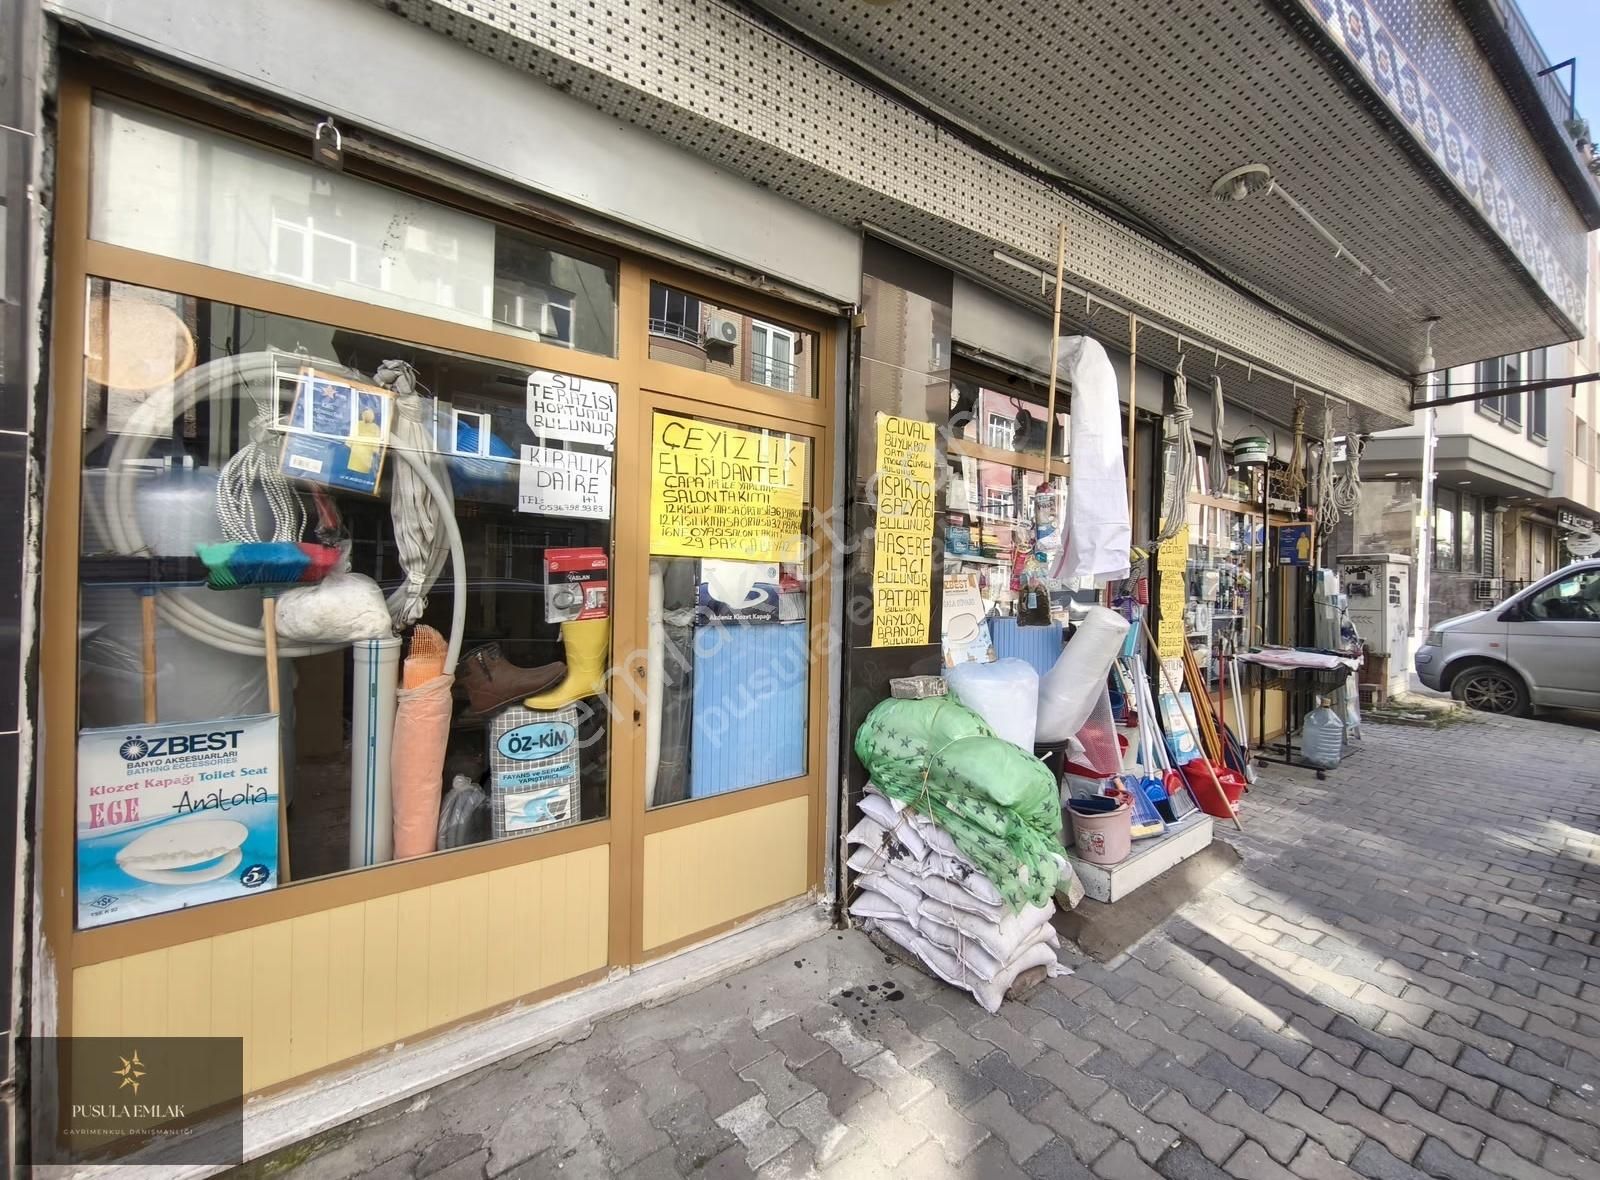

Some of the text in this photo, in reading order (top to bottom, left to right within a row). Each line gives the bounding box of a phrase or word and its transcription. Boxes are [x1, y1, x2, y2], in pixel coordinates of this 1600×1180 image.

[551, 375, 581, 392] SU
[533, 415, 615, 438] BULUNUR
[530, 448, 607, 475] KİRALIK
[659, 453, 689, 475] EL
[721, 461, 794, 487] DANTEL
[537, 470, 598, 494] DAİRE
[879, 516, 931, 531] BULUNUR
[877, 571, 929, 588] BULUNUR
[876, 613, 922, 626] NAYLON
[877, 622, 925, 639] BRANDA
[882, 637, 925, 646] BULUNUR
[119, 729, 244, 761] ÖZBEST
[508, 728, 569, 754] ÖZ-KİM
[126, 762, 170, 776] BATHING
[127, 751, 238, 770] BANYO AKSESUARLARI
[89, 766, 268, 797] Klozet Kapağı Toilet Seat
[502, 771, 531, 781] FAYANS
[172, 783, 268, 813] Anatolia
[89, 797, 140, 830] EGE
